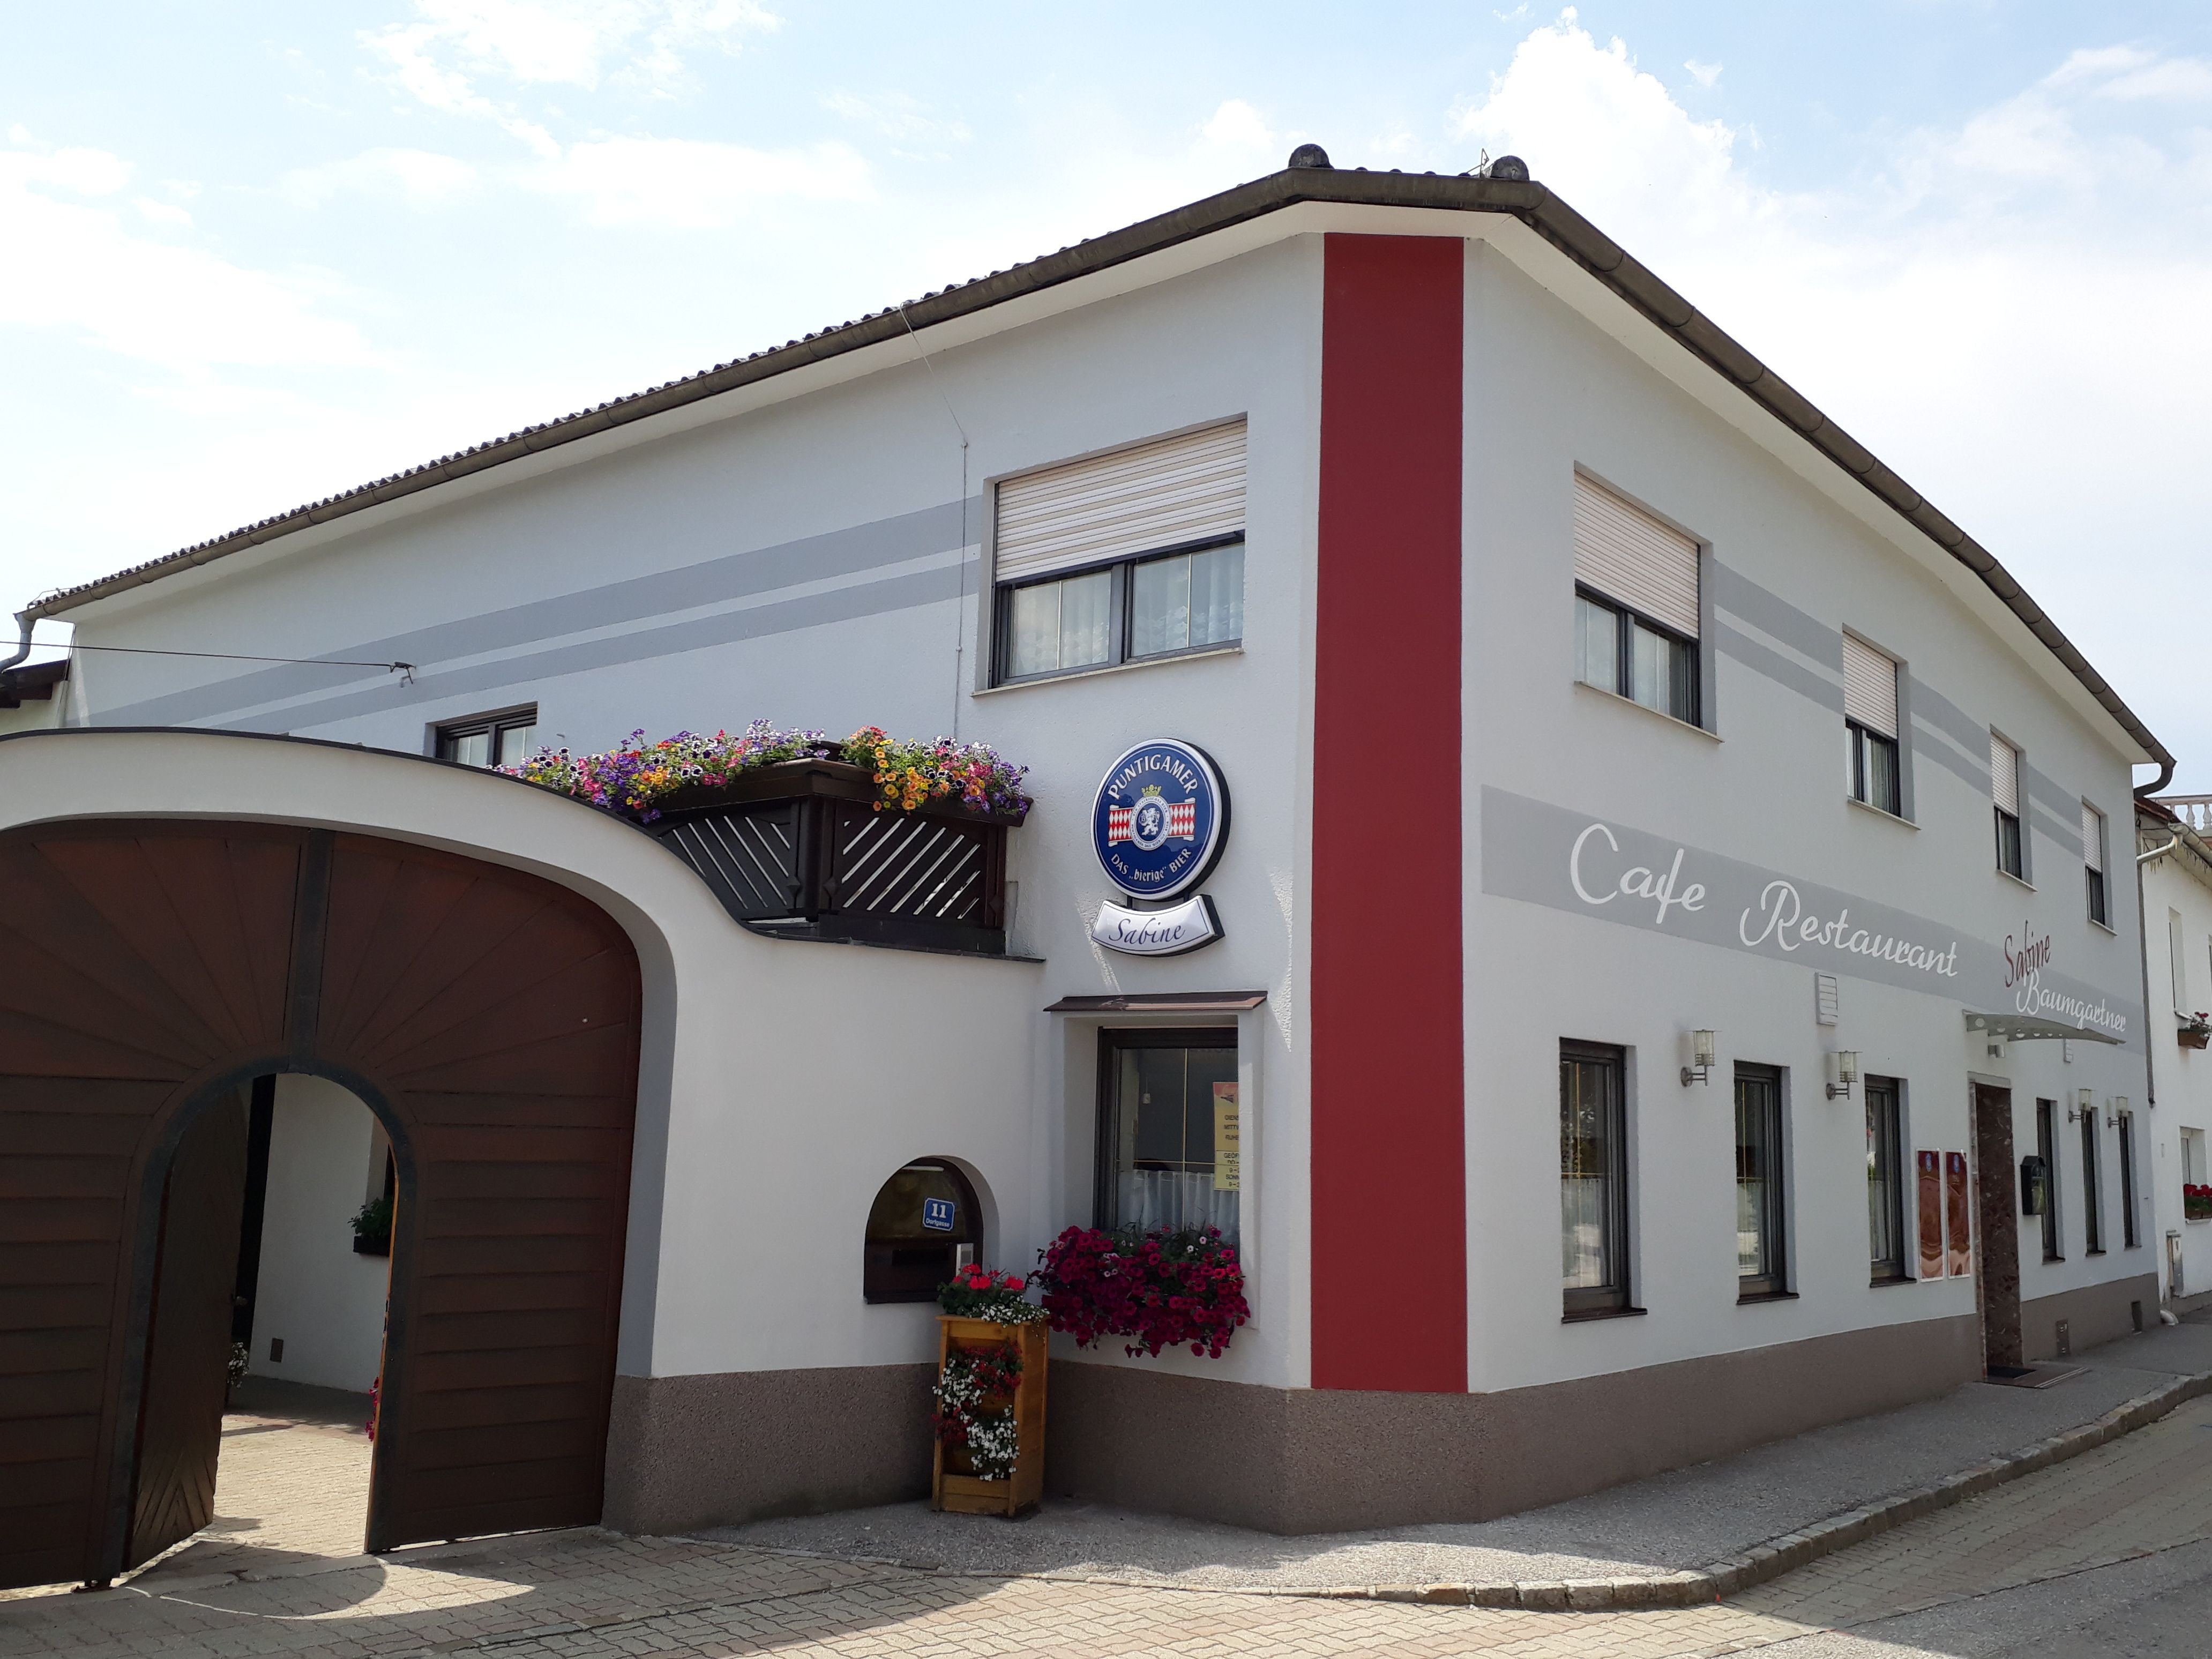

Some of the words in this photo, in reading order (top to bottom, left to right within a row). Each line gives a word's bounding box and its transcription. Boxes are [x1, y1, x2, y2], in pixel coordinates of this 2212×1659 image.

[1108, 754, 1198, 799] PUNTIGAMER
[1111, 854, 1129, 874] DAS
[1169, 848, 1192, 873] BIER
[1570, 823, 1705, 924] Cafe
[1739, 880, 1958, 977] Restaurant
[1109, 918, 1185, 945] Sabine
[2005, 920, 2051, 988] Sabine
[2016, 965, 2126, 1032] Baumgartner
[931, 1204, 946, 1218] 11
